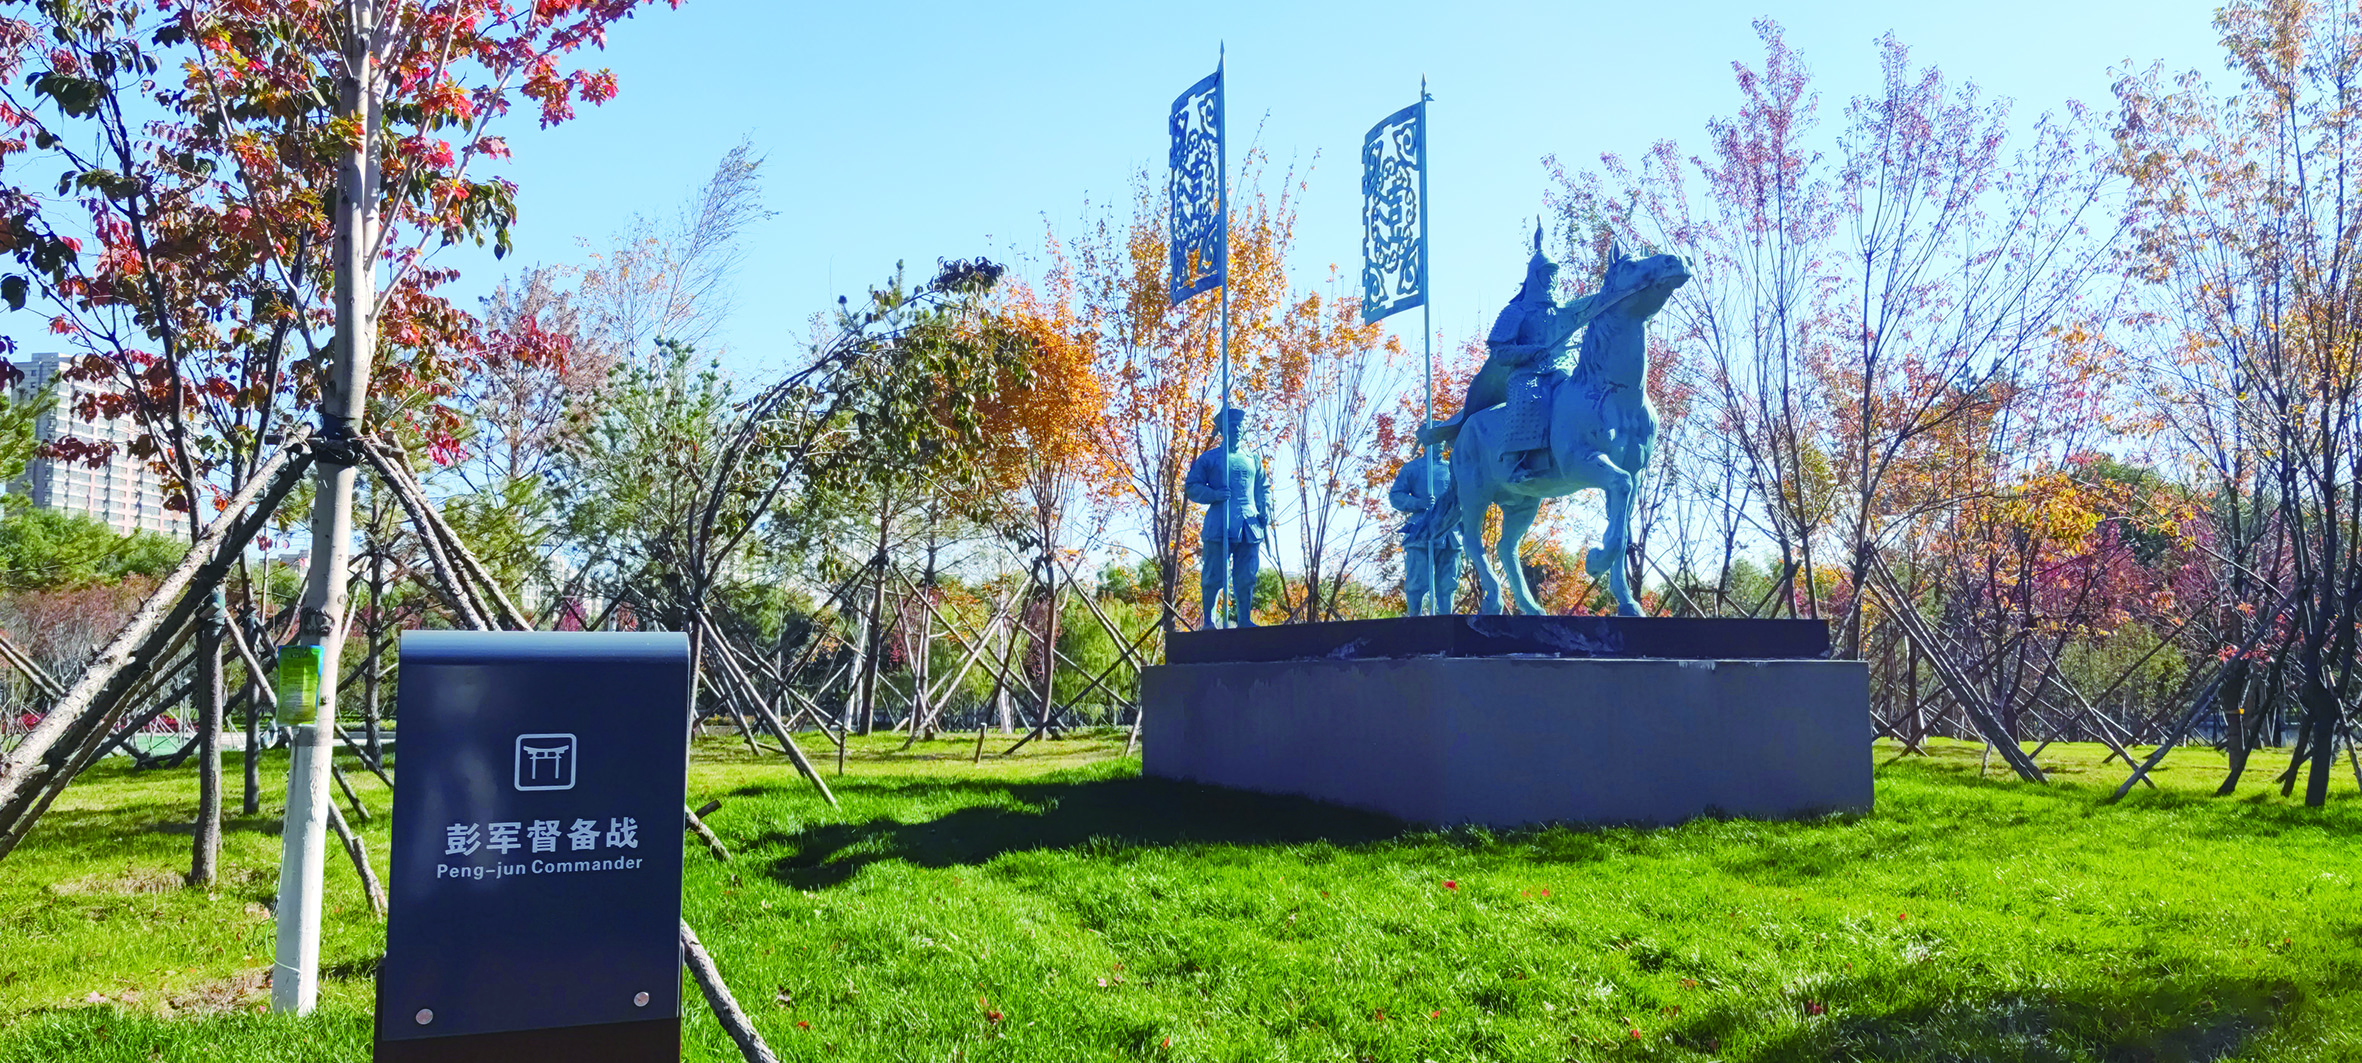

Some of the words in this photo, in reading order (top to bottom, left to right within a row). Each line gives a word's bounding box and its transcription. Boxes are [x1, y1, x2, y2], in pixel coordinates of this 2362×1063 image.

[444, 816, 639, 857] 彭军督备战
[436, 861, 526, 880] Peng-jun
[531, 855, 643, 874] Commander
